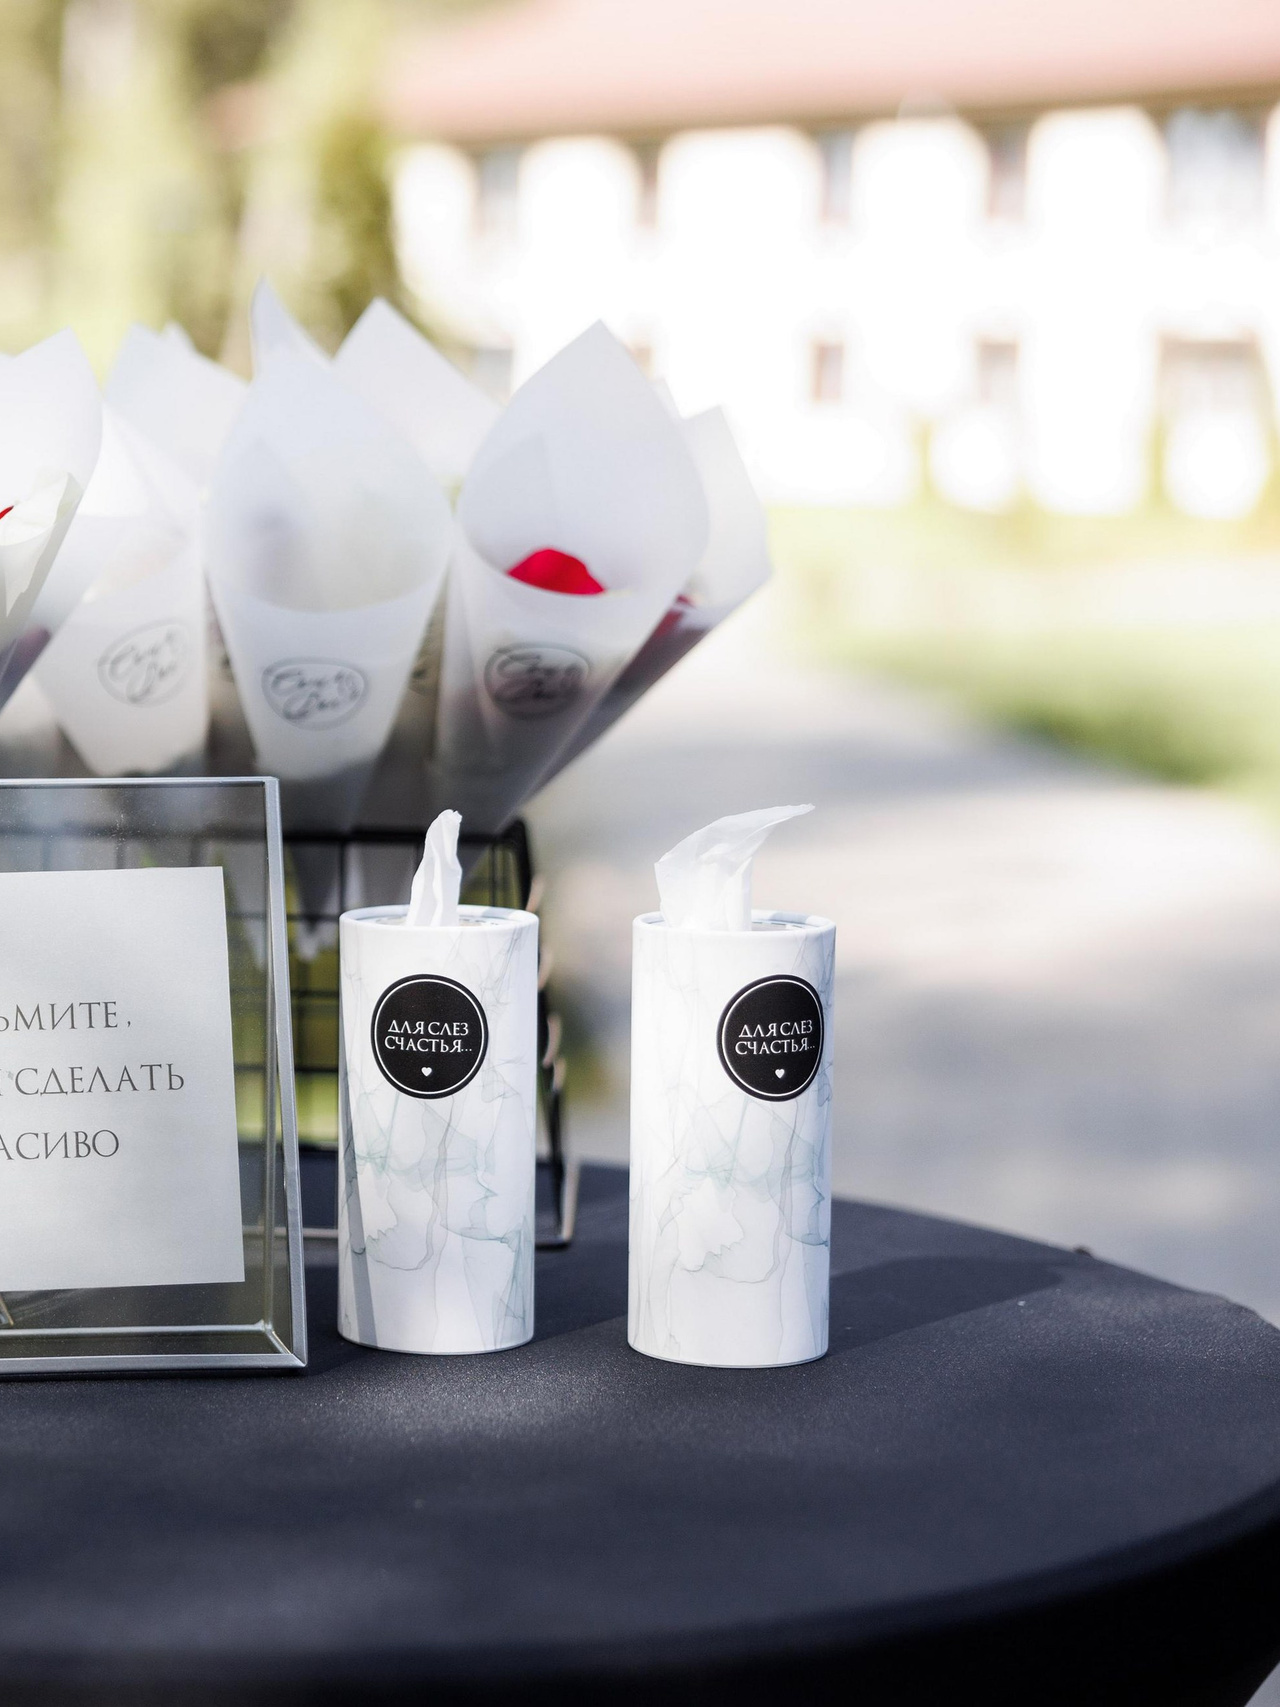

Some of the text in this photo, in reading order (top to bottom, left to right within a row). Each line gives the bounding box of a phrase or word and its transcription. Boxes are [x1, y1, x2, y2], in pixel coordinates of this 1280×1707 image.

[387, 1019, 469, 1036] ДЛЯ СЛЕЗ
[738, 1019, 813, 1038] ДЛЯ СЛЕЗ
[14, 1062, 185, 1097] СДЕЛАТЬ
